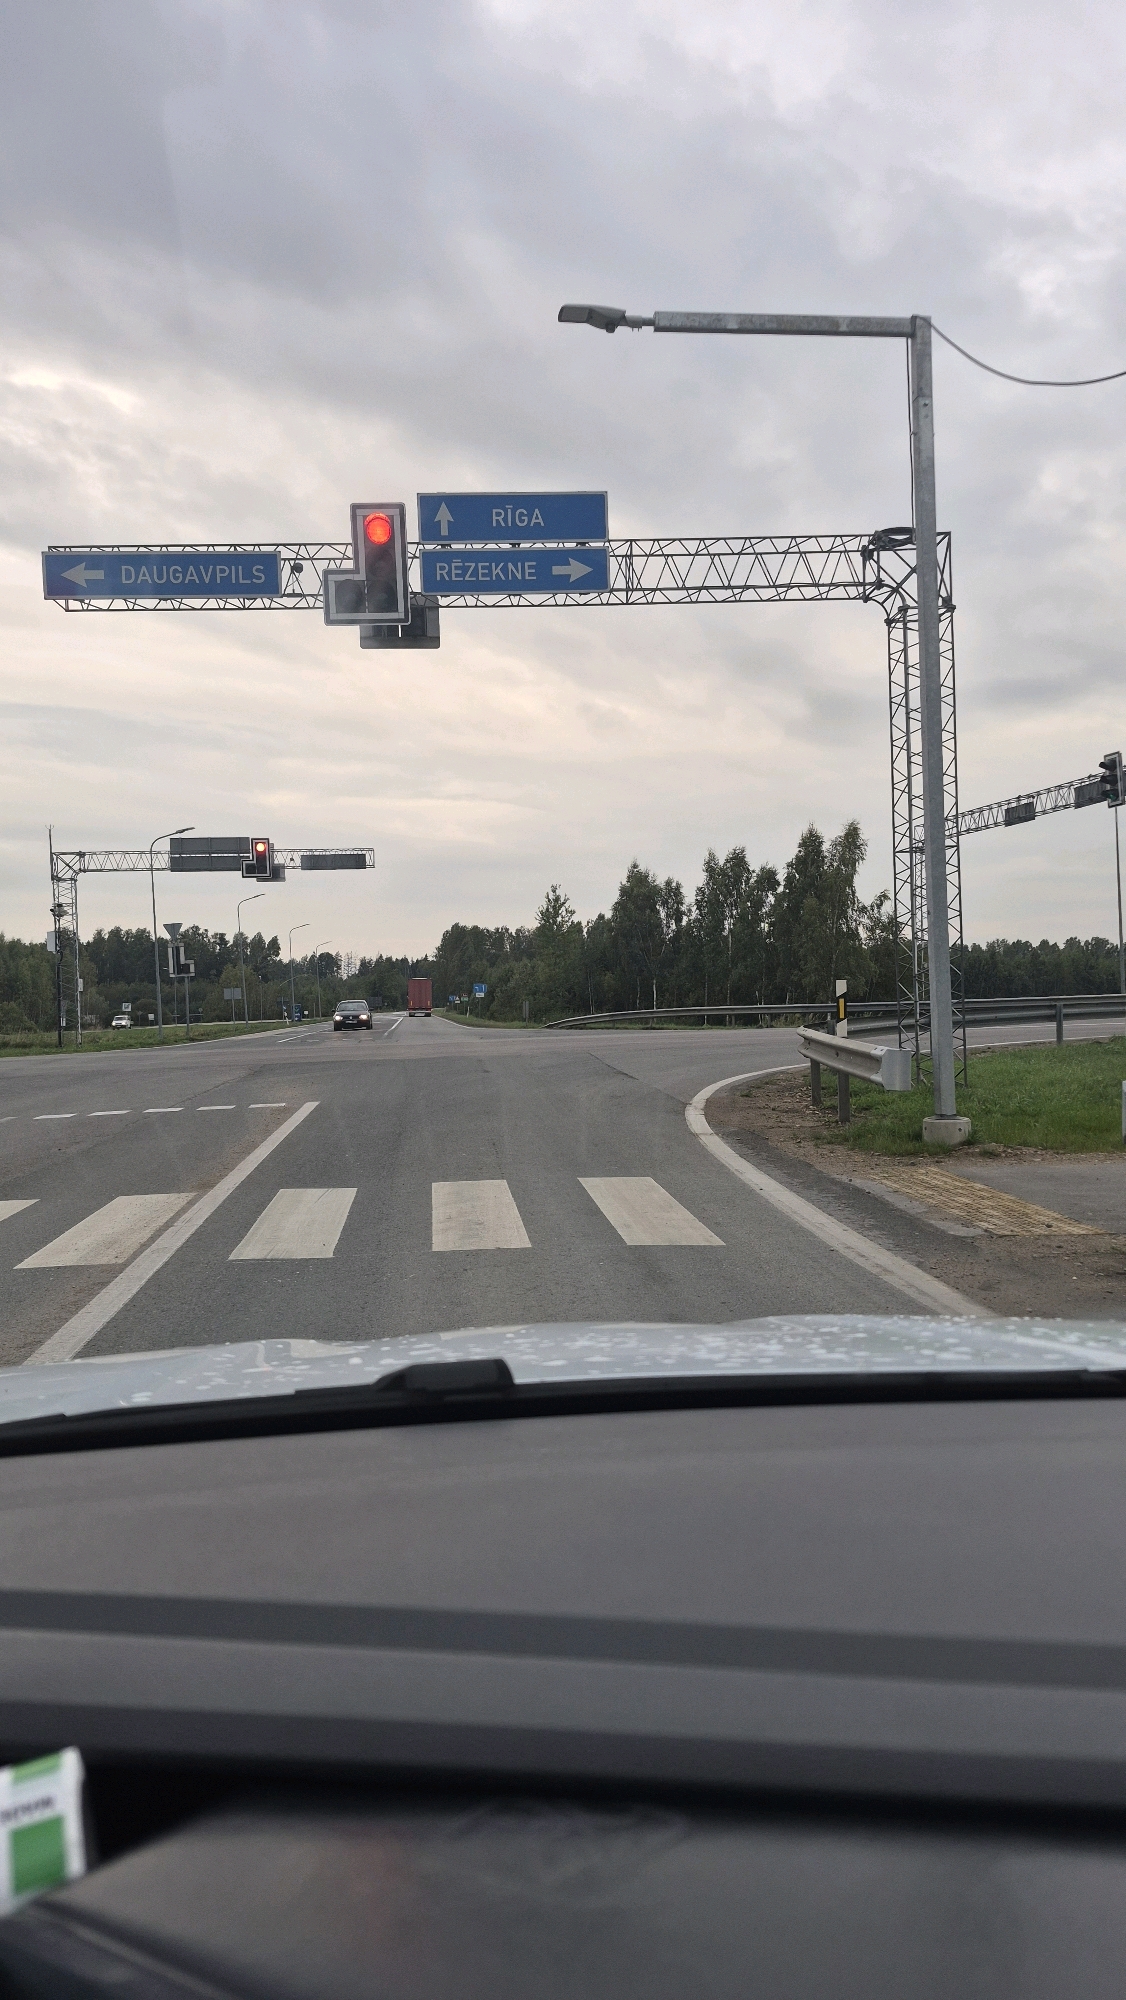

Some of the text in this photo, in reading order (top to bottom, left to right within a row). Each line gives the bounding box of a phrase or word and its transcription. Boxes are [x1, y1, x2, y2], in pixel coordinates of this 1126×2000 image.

[492, 505, 545, 527] RĪGA
[120, 564, 266, 585] DAUGAVPILS
[436, 559, 538, 581] RĒZEKNE
